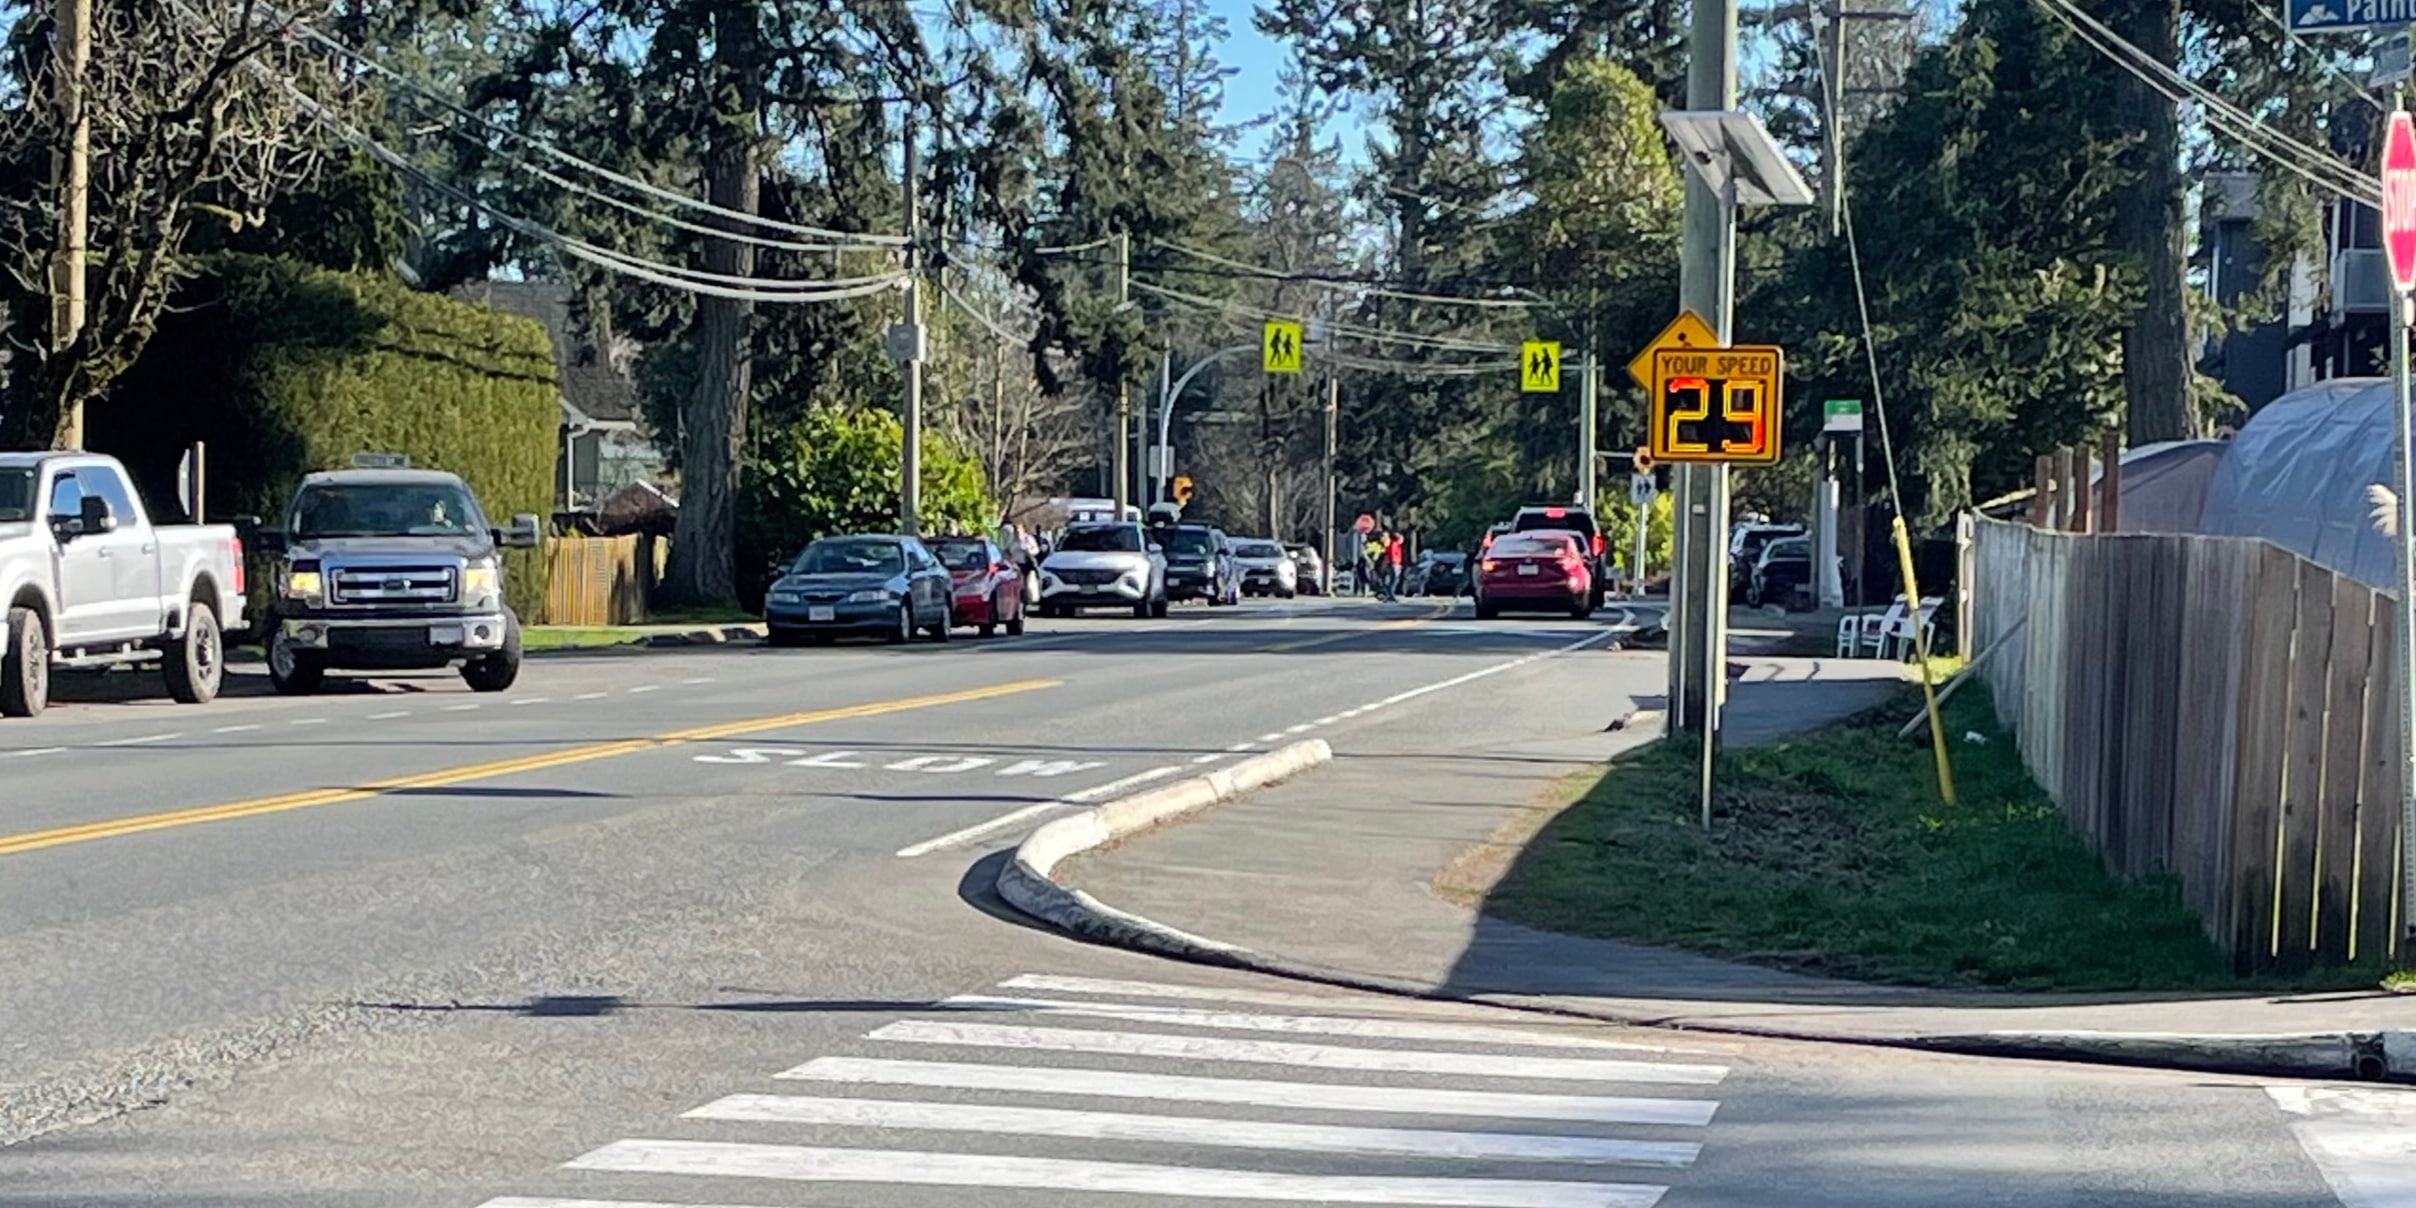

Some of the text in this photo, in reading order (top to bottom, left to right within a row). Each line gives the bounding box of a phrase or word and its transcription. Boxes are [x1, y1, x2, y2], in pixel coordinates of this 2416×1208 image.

[1662, 356, 1772, 375] YOUR SPEED
[1669, 377, 1766, 454] 29
[693, 748, 1109, 776] SLOW
